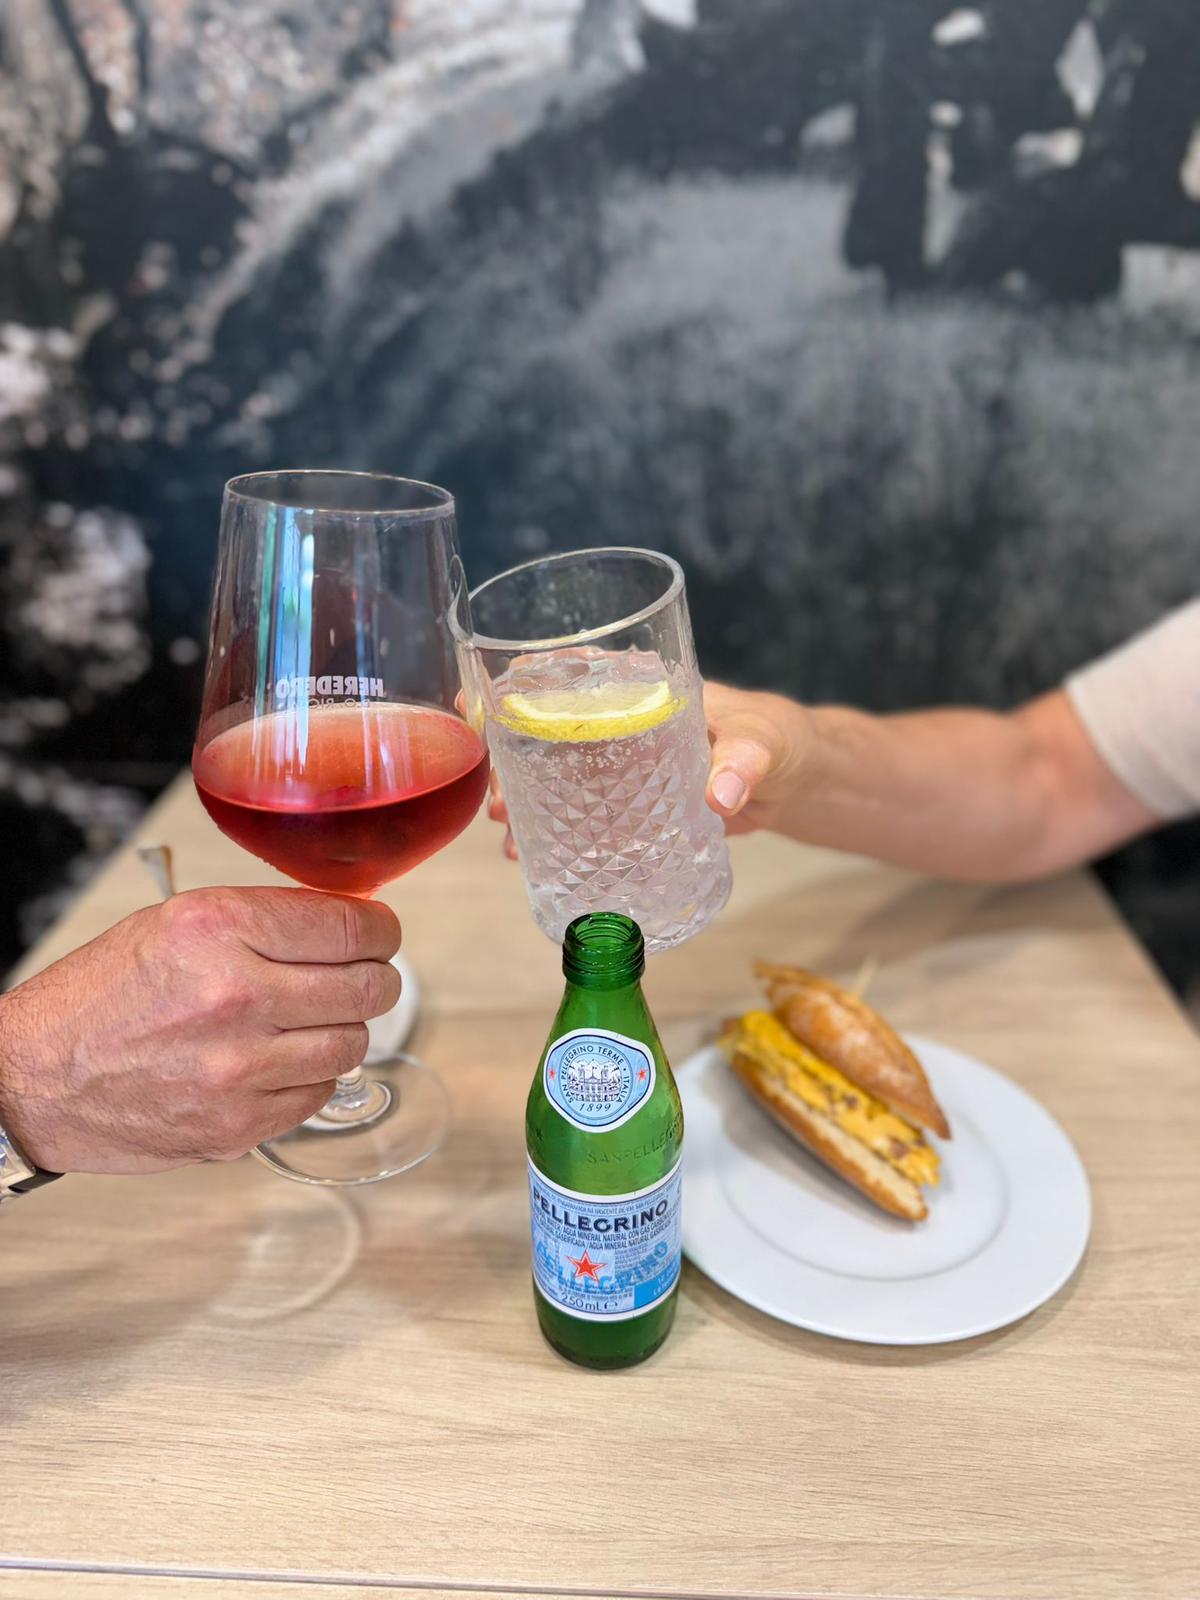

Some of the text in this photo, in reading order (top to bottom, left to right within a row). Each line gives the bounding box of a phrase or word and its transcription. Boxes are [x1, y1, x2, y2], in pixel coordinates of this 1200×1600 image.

[561, 1045, 631, 1104] SAN PELLEGRINO TERME ITALIA
[579, 1103, 612, 1113] 1899
[533, 1186, 668, 1233] PELLEGRINO
[577, 1230, 601, 1242] MINERAL
[602, 1232, 627, 1242] NATURAL
[640, 1223, 650, 1235] GAS
[604, 1240, 627, 1250] MINERAL
